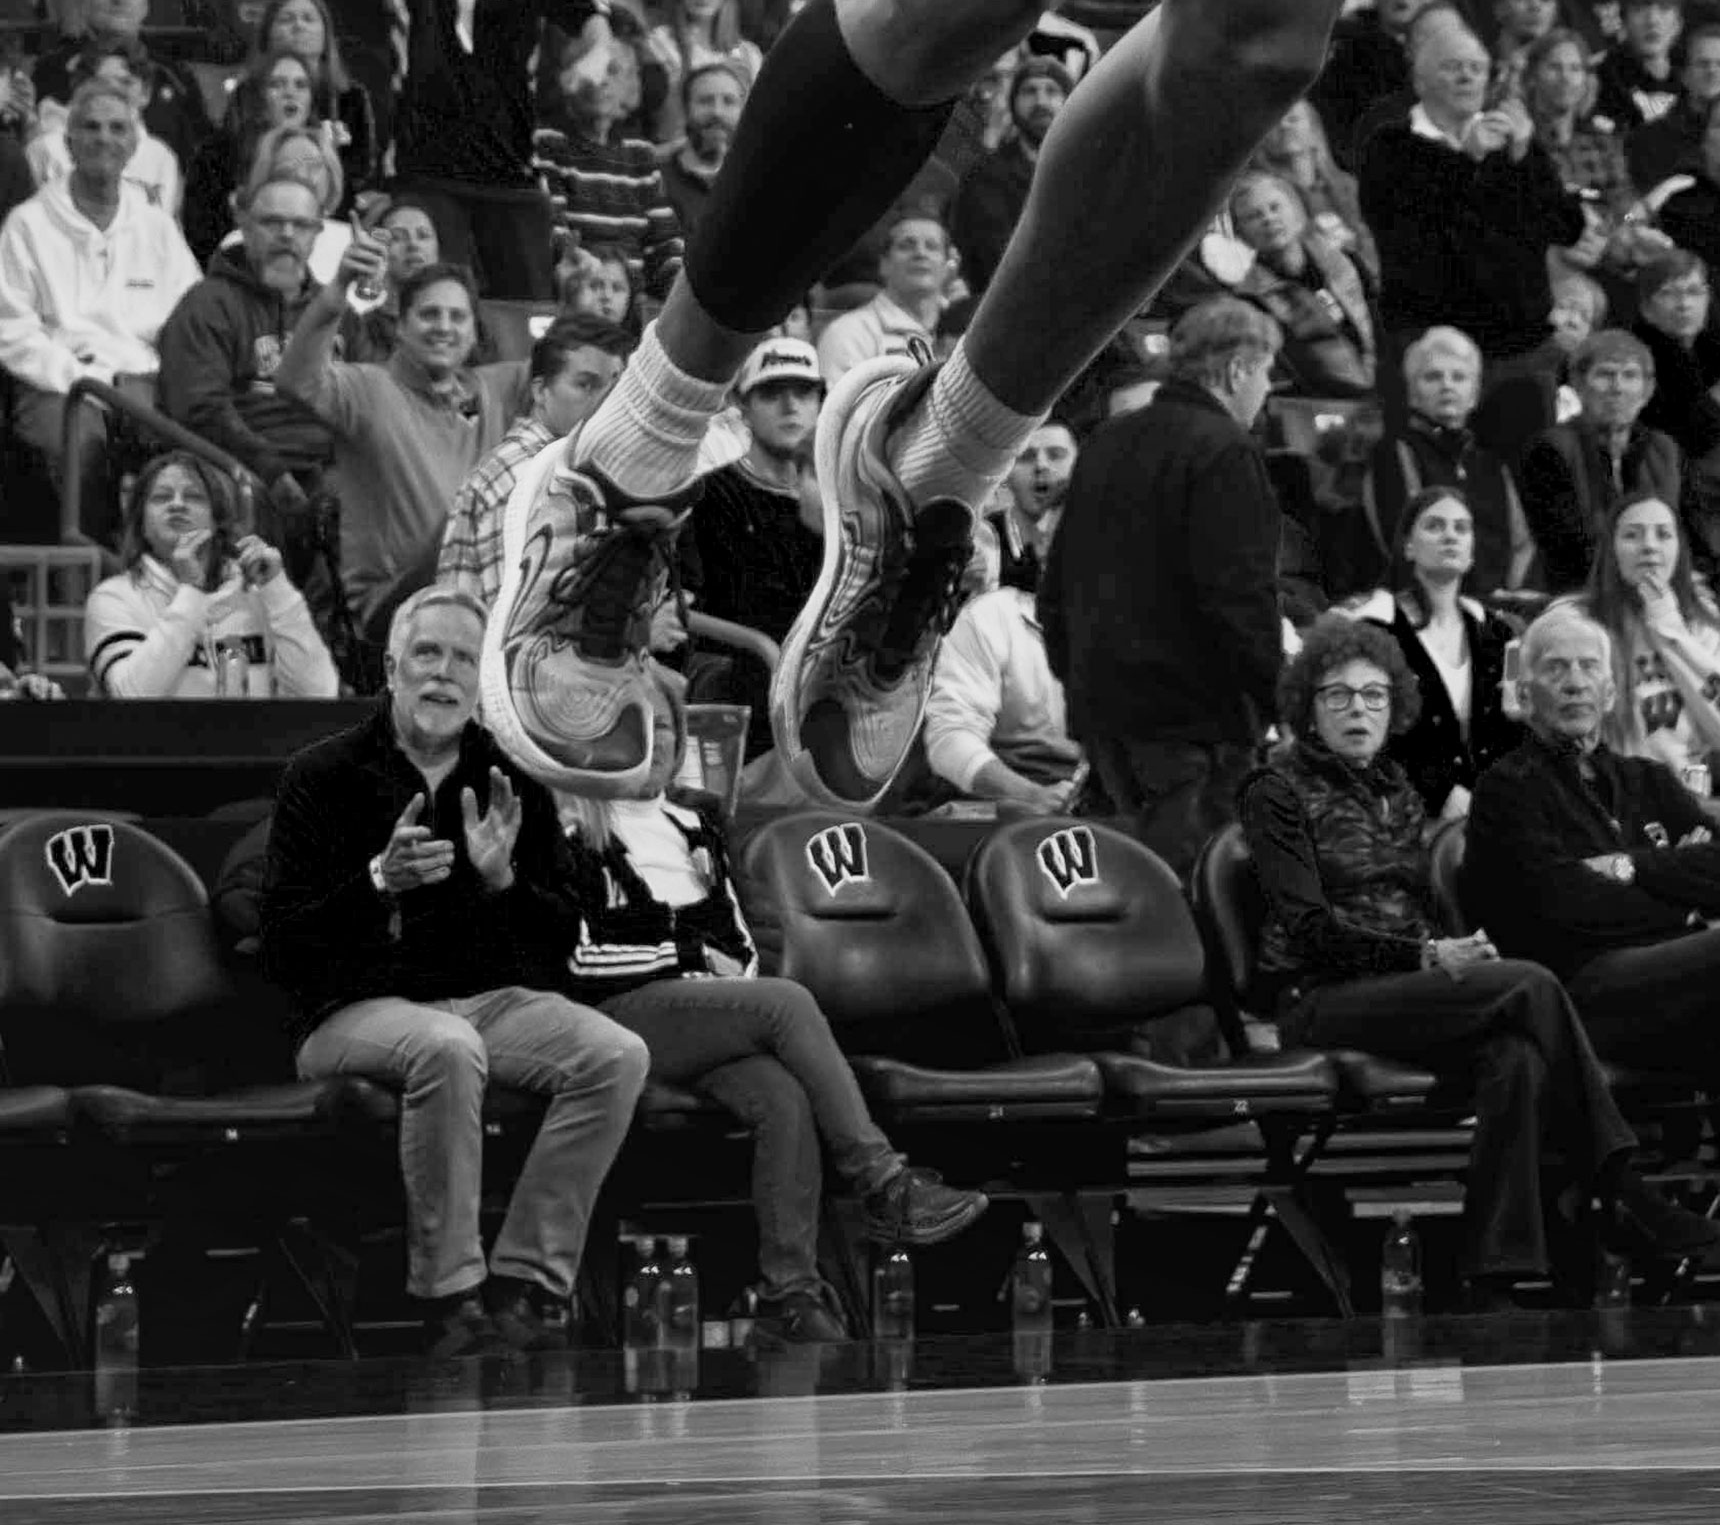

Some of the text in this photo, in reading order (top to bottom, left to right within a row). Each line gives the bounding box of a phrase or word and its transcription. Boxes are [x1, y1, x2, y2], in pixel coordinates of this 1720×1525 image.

[46, 824, 114, 896] W
[805, 822, 869, 896] W
[1035, 825, 1099, 898] W
